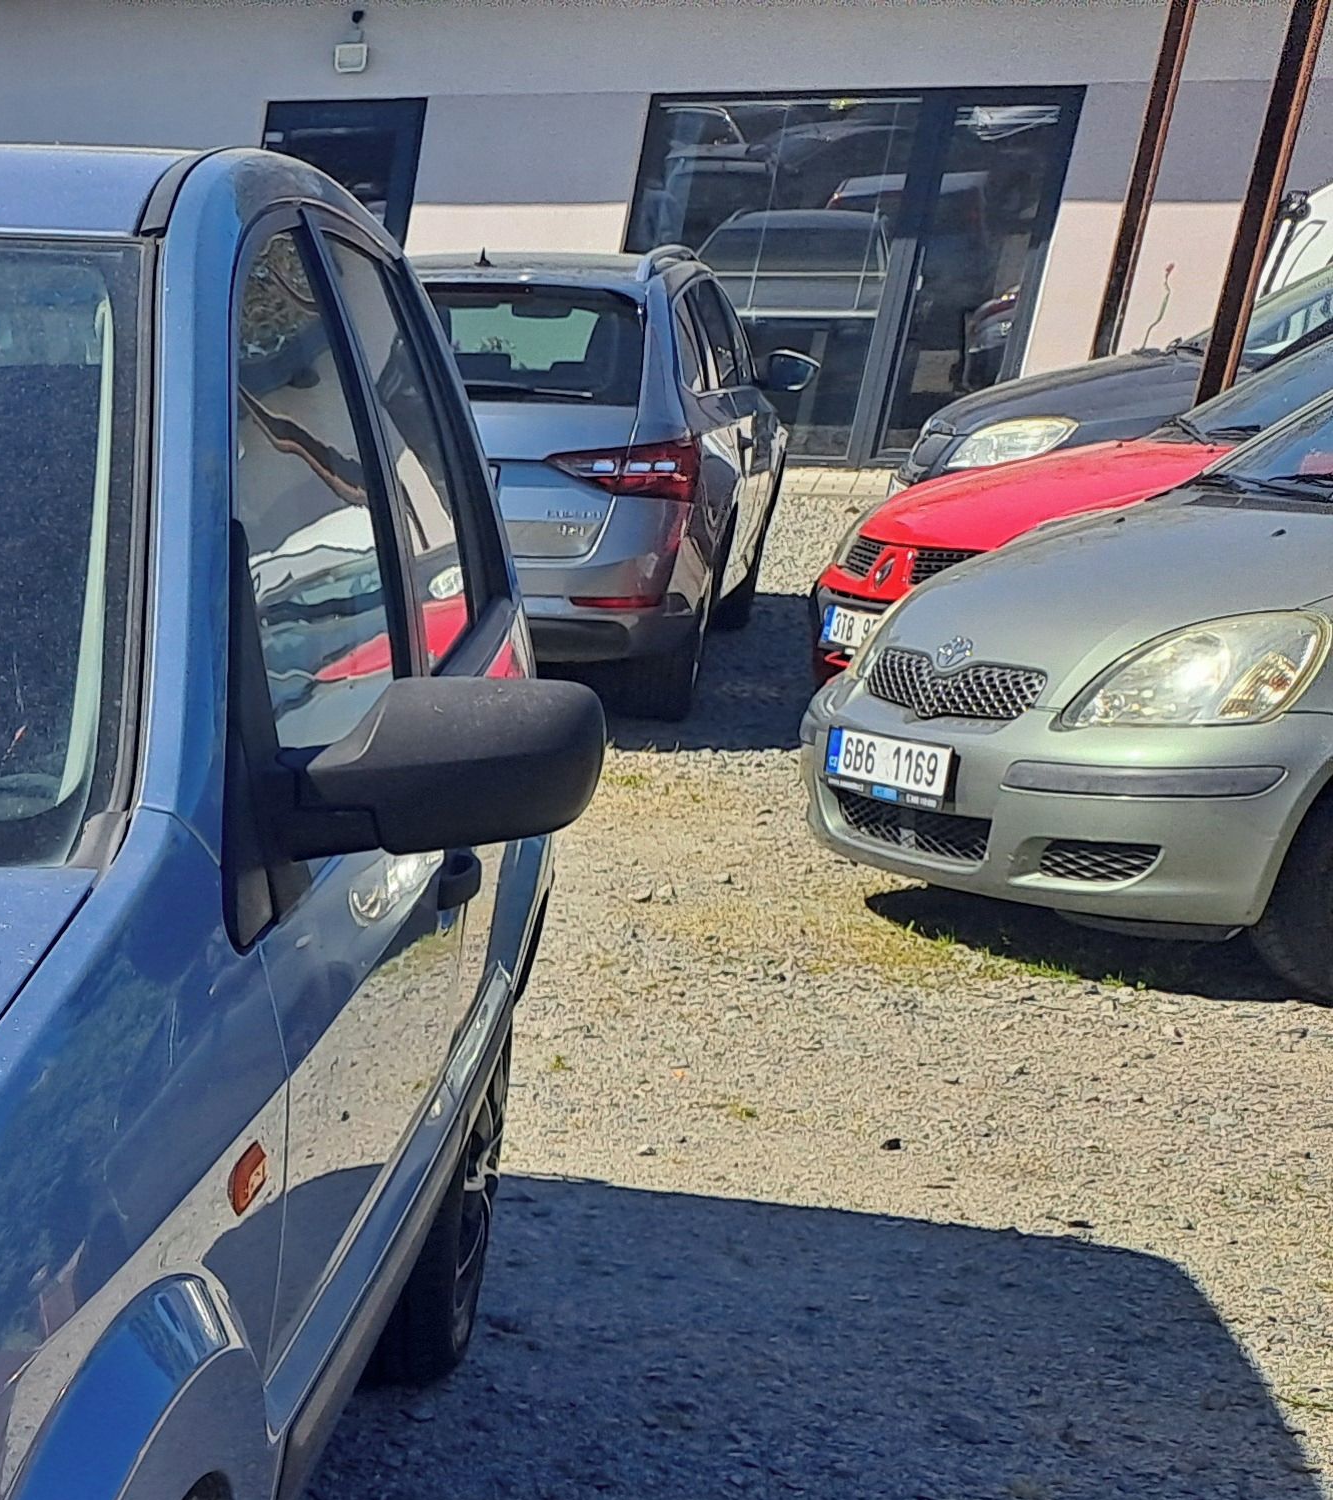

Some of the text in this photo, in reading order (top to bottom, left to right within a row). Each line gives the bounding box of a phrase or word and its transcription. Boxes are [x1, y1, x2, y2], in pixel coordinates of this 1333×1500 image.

[833, 613, 855, 642] 3T8
[843, 736, 938, 787] 6B6 1169
